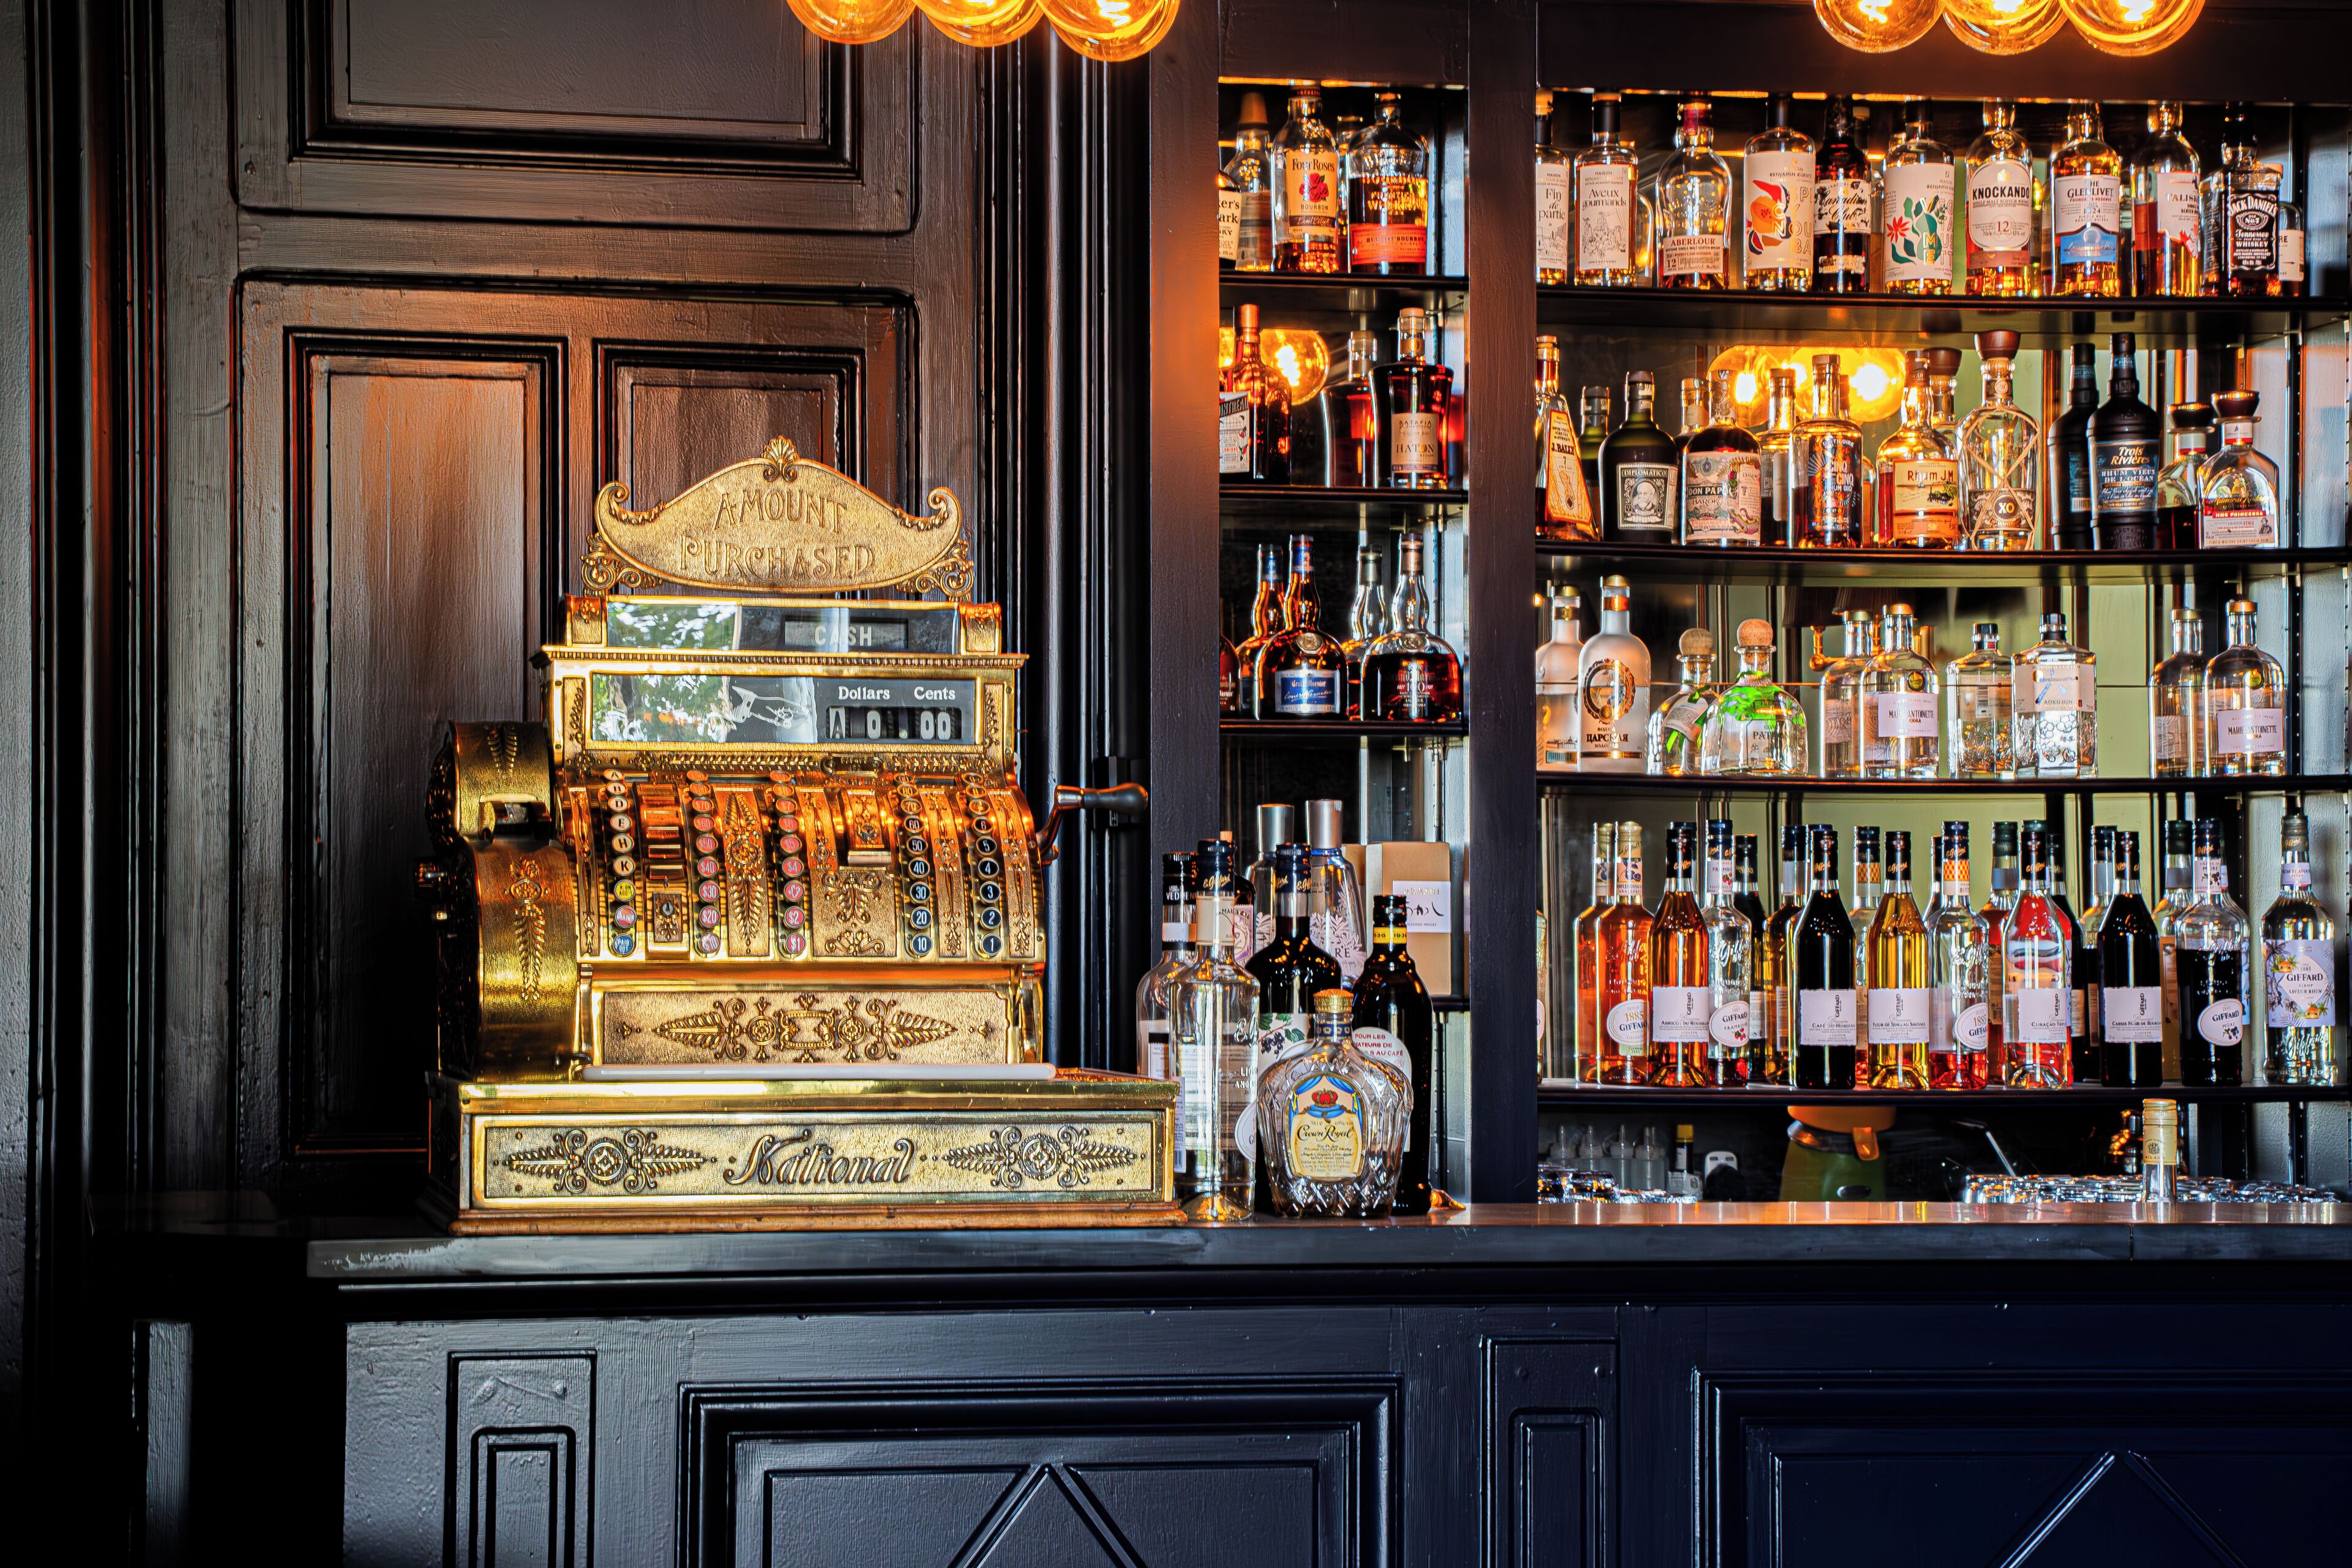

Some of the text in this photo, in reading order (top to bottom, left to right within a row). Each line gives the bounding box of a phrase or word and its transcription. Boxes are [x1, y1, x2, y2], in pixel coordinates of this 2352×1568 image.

[1292, 158, 1336, 172] Four Roses
[1546, 188, 1561, 202] Fin
[1588, 188, 1619, 198] Aveux
[1972, 186, 2030, 200] KNOCKANDO
[2067, 187, 2114, 198] GLENLIVET
[1300, 203, 1329, 212] BOURBON
[1549, 200, 1559, 209] de
[1582, 197, 1627, 211] gourmands
[2227, 195, 2278, 216] JACK DANIEL'S
[1539, 209, 1566, 222] partie
[1997, 221, 2010, 232] 12
[2235, 229, 2269, 238] Tennessee
[1670, 238, 1716, 247] ABERLOUR
[1667, 258, 1677, 268] 12
[2119, 446, 2144, 457] Trois
[1836, 473, 1854, 487] CINQ
[1907, 470, 1937, 481] Rhum
[1688, 487, 1703, 496] DON
[714, 489, 848, 533] AMOUNT
[1998, 502, 2016, 514] XO
[680, 533, 876, 581] PURCHASED
[814, 625, 873, 647] CASH
[838, 685, 956, 701] Dollars Cents
[1907, 710, 1935, 718] ANTOINETTE
[829, 707, 846, 740] A
[2228, 725, 2245, 736] MARIE
[908, 820, 920, 829] 60
[912, 840, 923, 851] 50
[982, 840, 990, 851] 5
[700, 862, 715, 873] $40
[786, 861, 798, 872] $4
[913, 861, 925, 875] 40
[984, 862, 991, 875] 4
[703, 886, 717, 898] $30
[915, 886, 927, 899] 30
[987, 885, 993, 899] 3
[703, 911, 717, 924] $20
[788, 911, 800, 924] $2
[916, 911, 927, 925] 20
[989, 911, 995, 925] 2
[791, 937, 802, 949] $1
[917, 938, 927, 950] 10
[990, 938, 994, 951] 1
[2286, 973, 2324, 982] GIFFARD
[1624, 1011, 1645, 1022] 1885
[1722, 1011, 1748, 1023] GIFFARD
[2212, 1010, 2239, 1022] GIFFARD
[1297, 1124, 1354, 1142] Crown Royal
[723, 1129, 918, 1186] National
